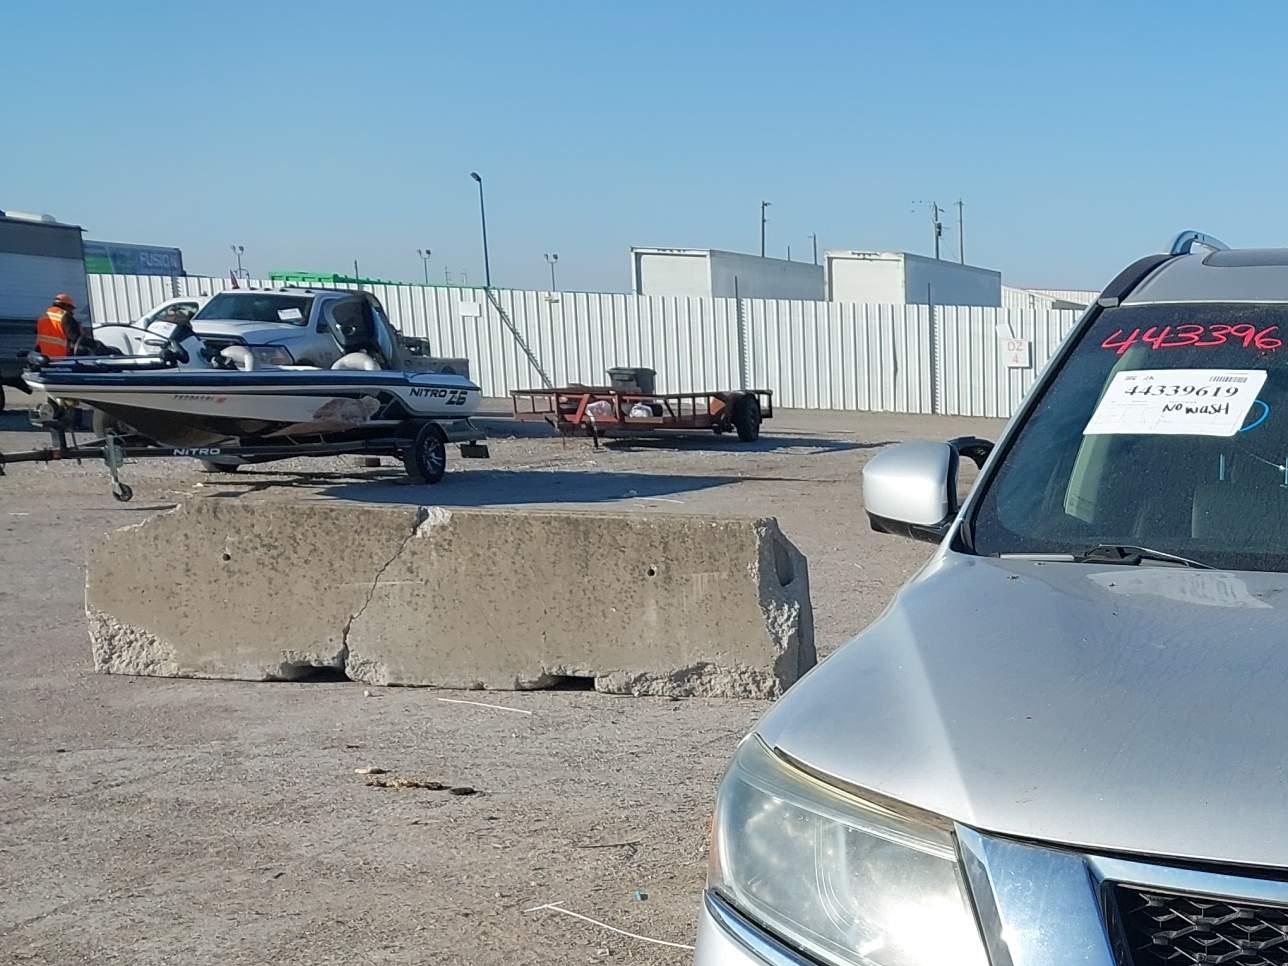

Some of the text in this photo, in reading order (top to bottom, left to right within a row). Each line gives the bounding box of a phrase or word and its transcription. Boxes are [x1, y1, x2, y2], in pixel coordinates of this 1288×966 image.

[409, 387, 448, 399] NITRO
[1124, 384, 1239, 398] 44339619
[173, 447, 221, 456] NITRO
